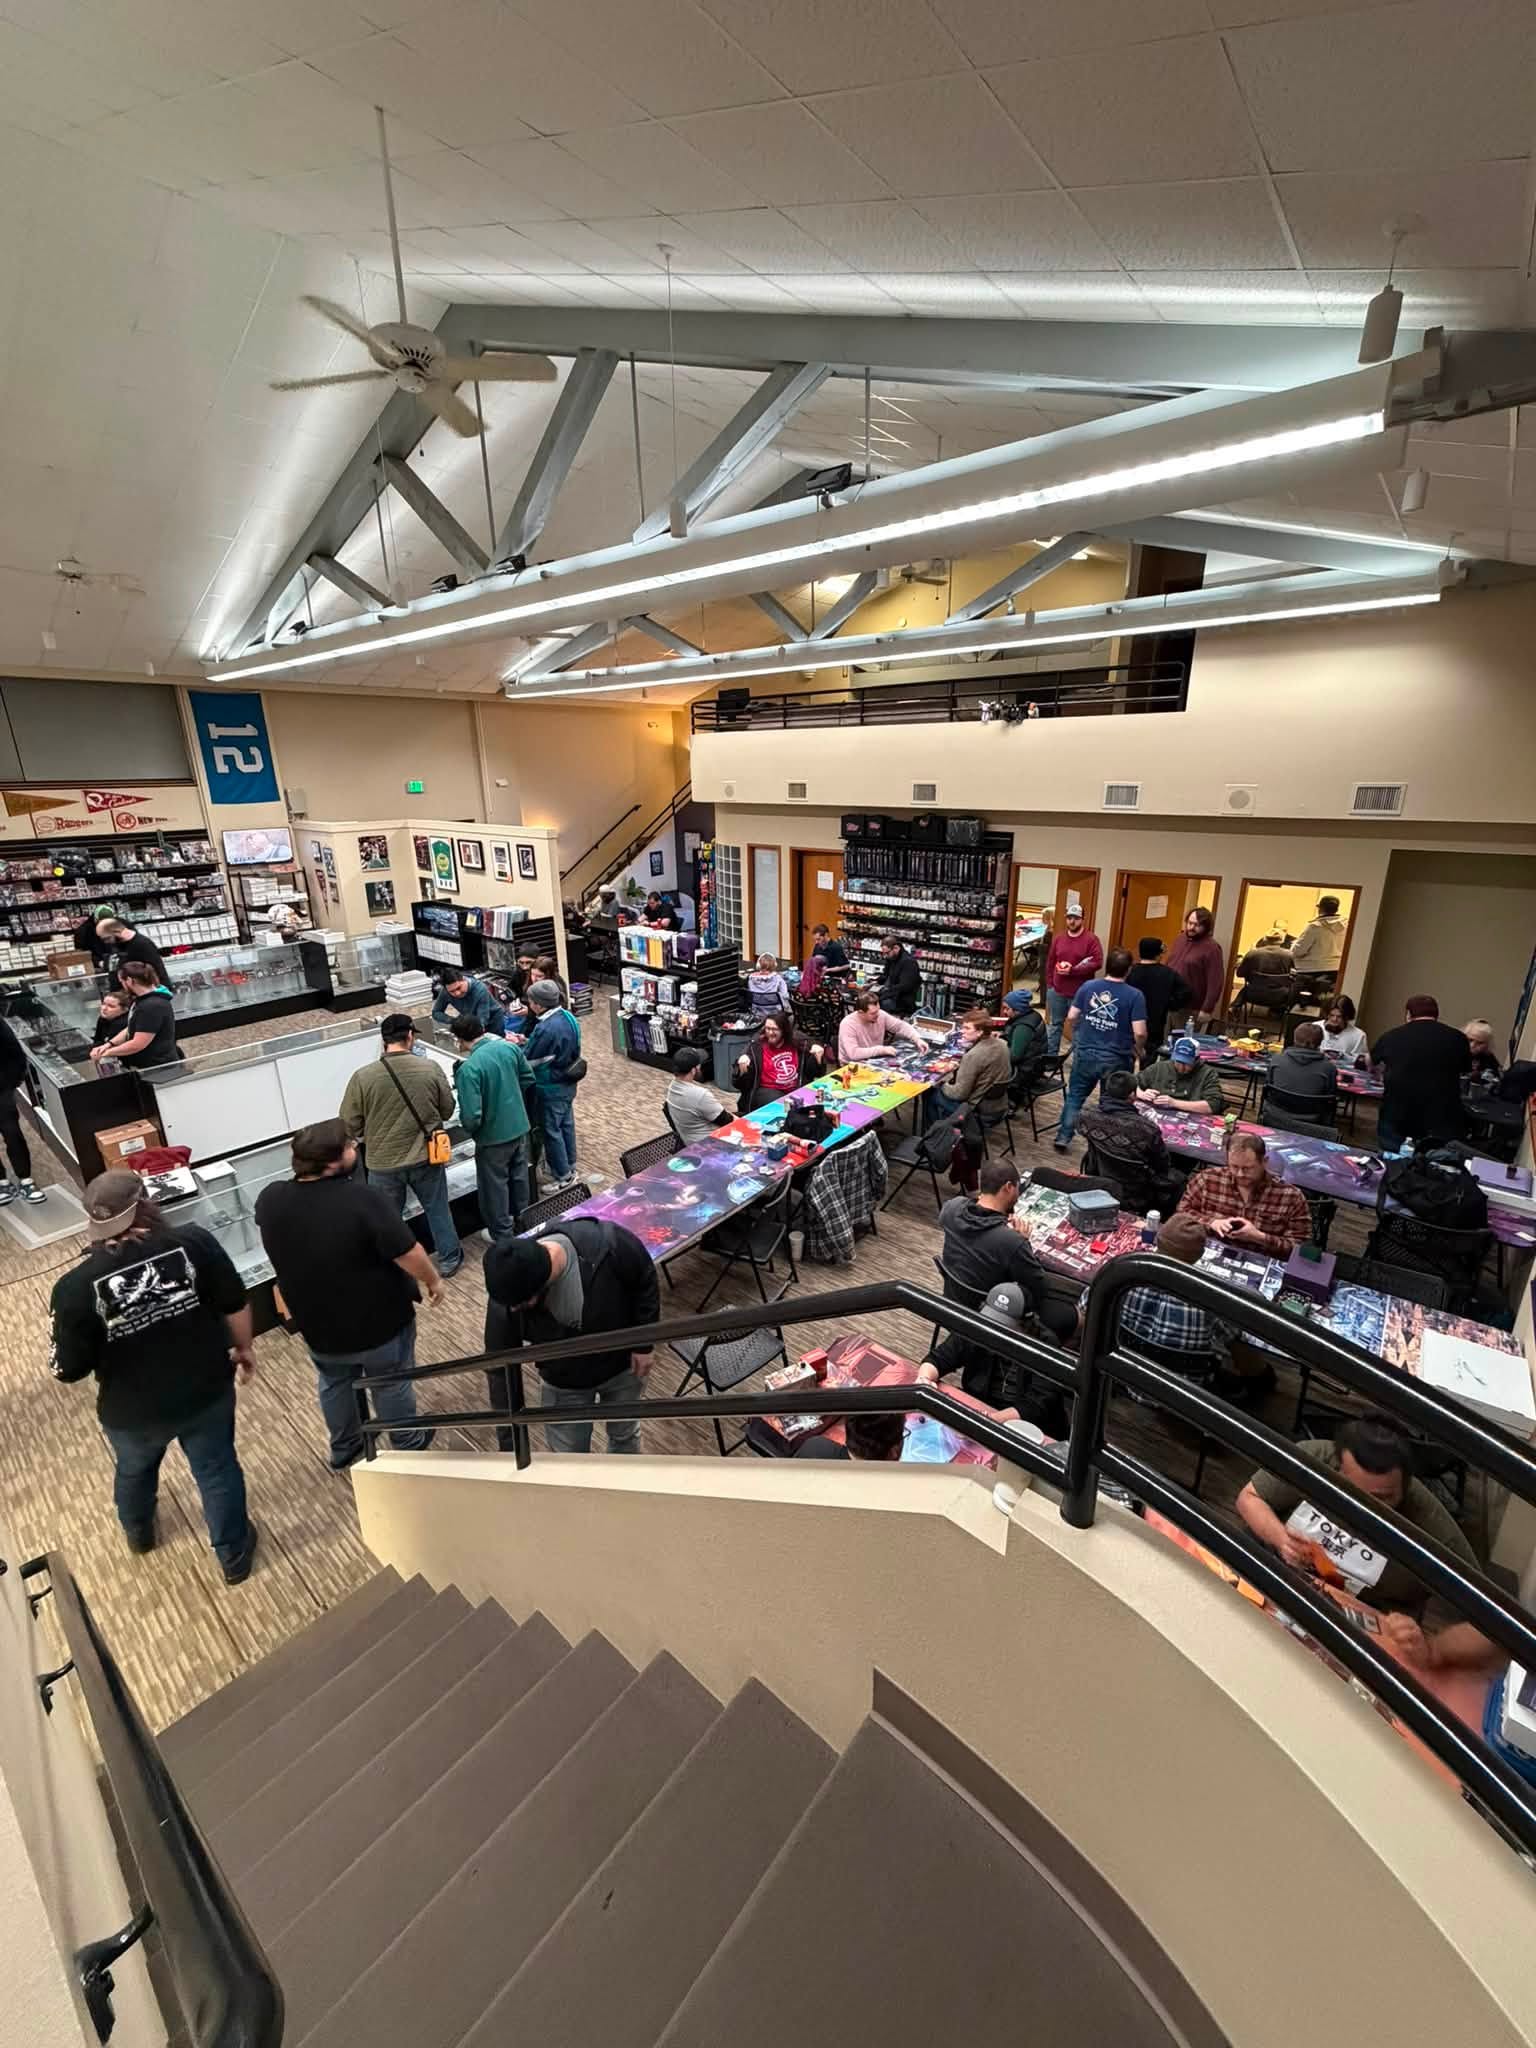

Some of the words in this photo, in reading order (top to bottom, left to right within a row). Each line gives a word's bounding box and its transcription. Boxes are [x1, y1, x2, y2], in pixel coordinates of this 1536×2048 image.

[207, 722, 264, 774] 12
[55, 817, 93, 831] Rangers
[1308, 1511, 1374, 1562] TOKYO
[1320, 1536, 1348, 1560] 東京
